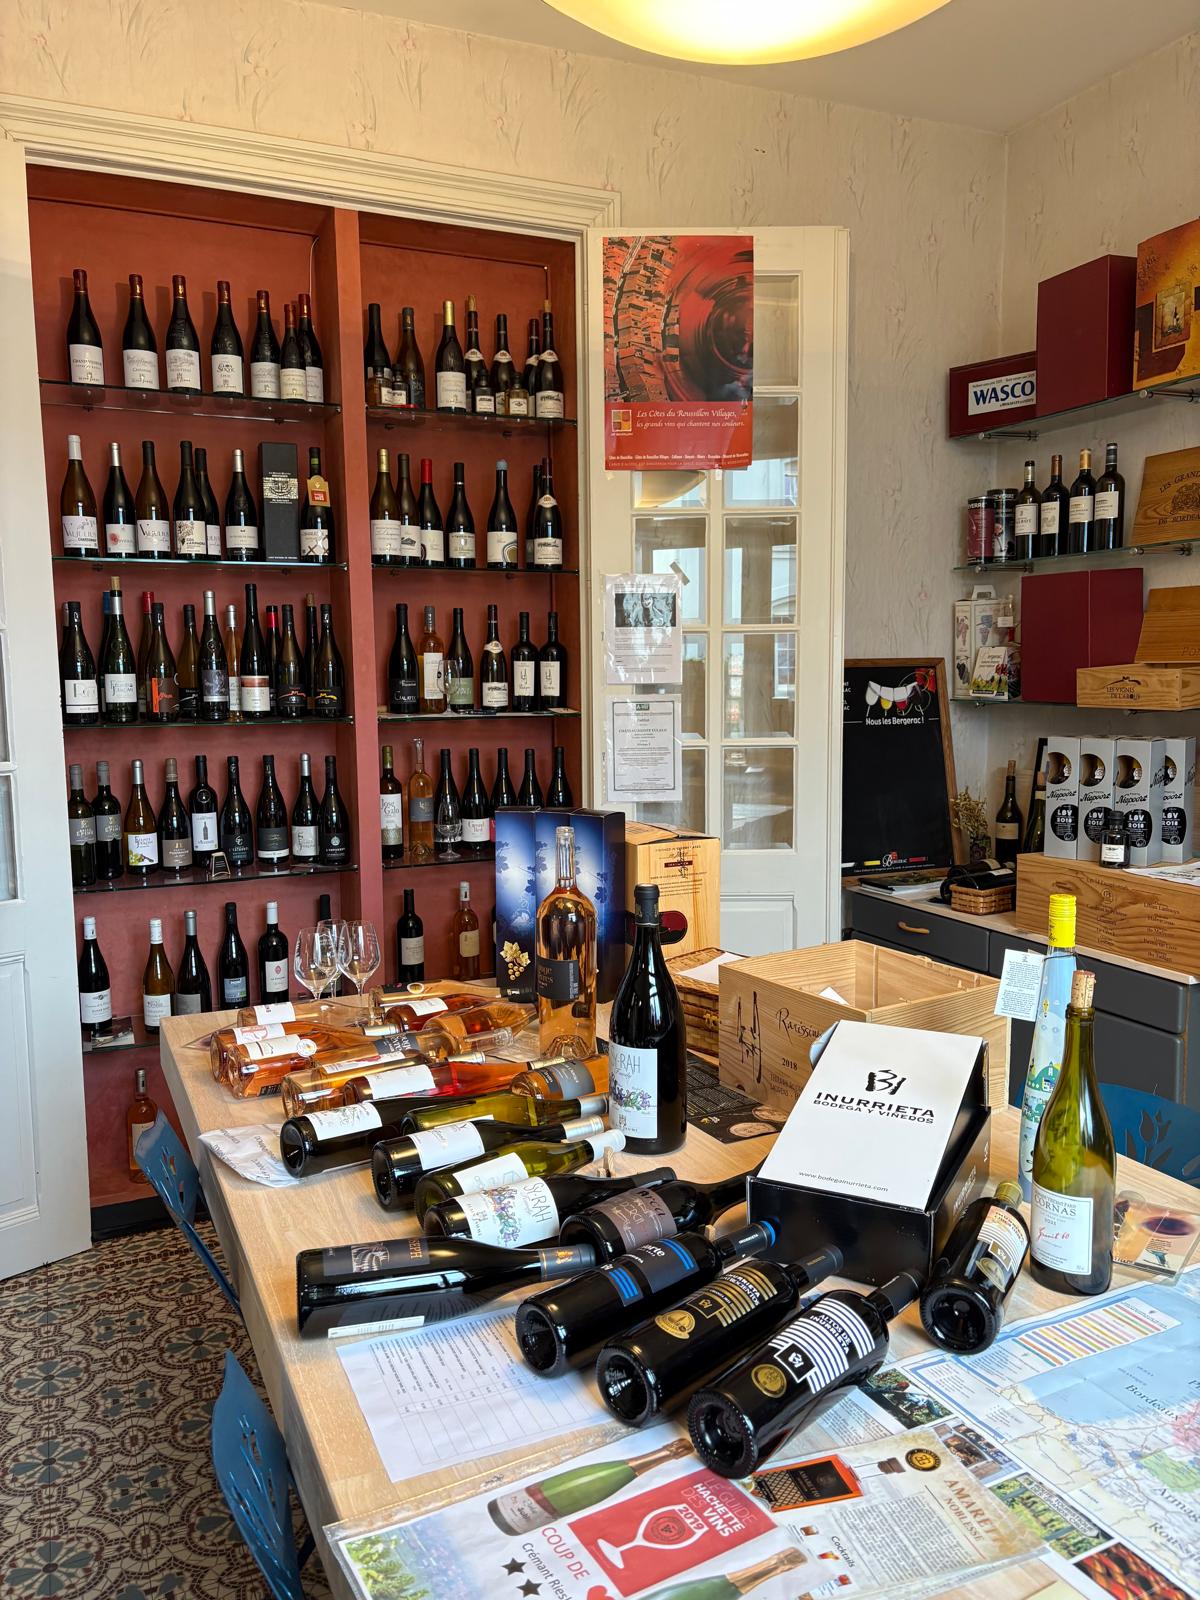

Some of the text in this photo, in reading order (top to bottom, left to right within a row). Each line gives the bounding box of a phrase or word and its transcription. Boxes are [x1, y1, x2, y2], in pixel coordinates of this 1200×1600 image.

[973, 380, 1035, 406] WASCO
[637, 408, 736, 419] Les Côtes du Roussillon Villages,
[866, 718, 881, 726] Nous
[882, 717, 892, 725] les
[892, 717, 920, 726] Bergerac
[782, 1057, 798, 1071] 2018
[813, 1100, 862, 1113] BODEGA
[815, 1091, 935, 1118] INURRIETA
[798, 1171, 889, 1193] www.bodegainurrieta.com
[1034, 1195, 1077, 1217] CORNAS
[809, 1315, 850, 1354] INURRIETA
[819, 1314, 852, 1345] ALTOS DE
[1125, 1384, 1180, 1422] Bordeaux
[680, 1487, 735, 1537] DES VINS
[693, 1483, 745, 1532] HACHETTE
[703, 1477, 759, 1525] LE GUIDE
[676, 1506, 705, 1530] 2019
[946, 1496, 984, 1542] NOBLESSE
[521, 1541, 555, 1581] Crémant
[541, 1526, 590, 1580] COUP DE
[831, 1536, 855, 1568] Cocktails
